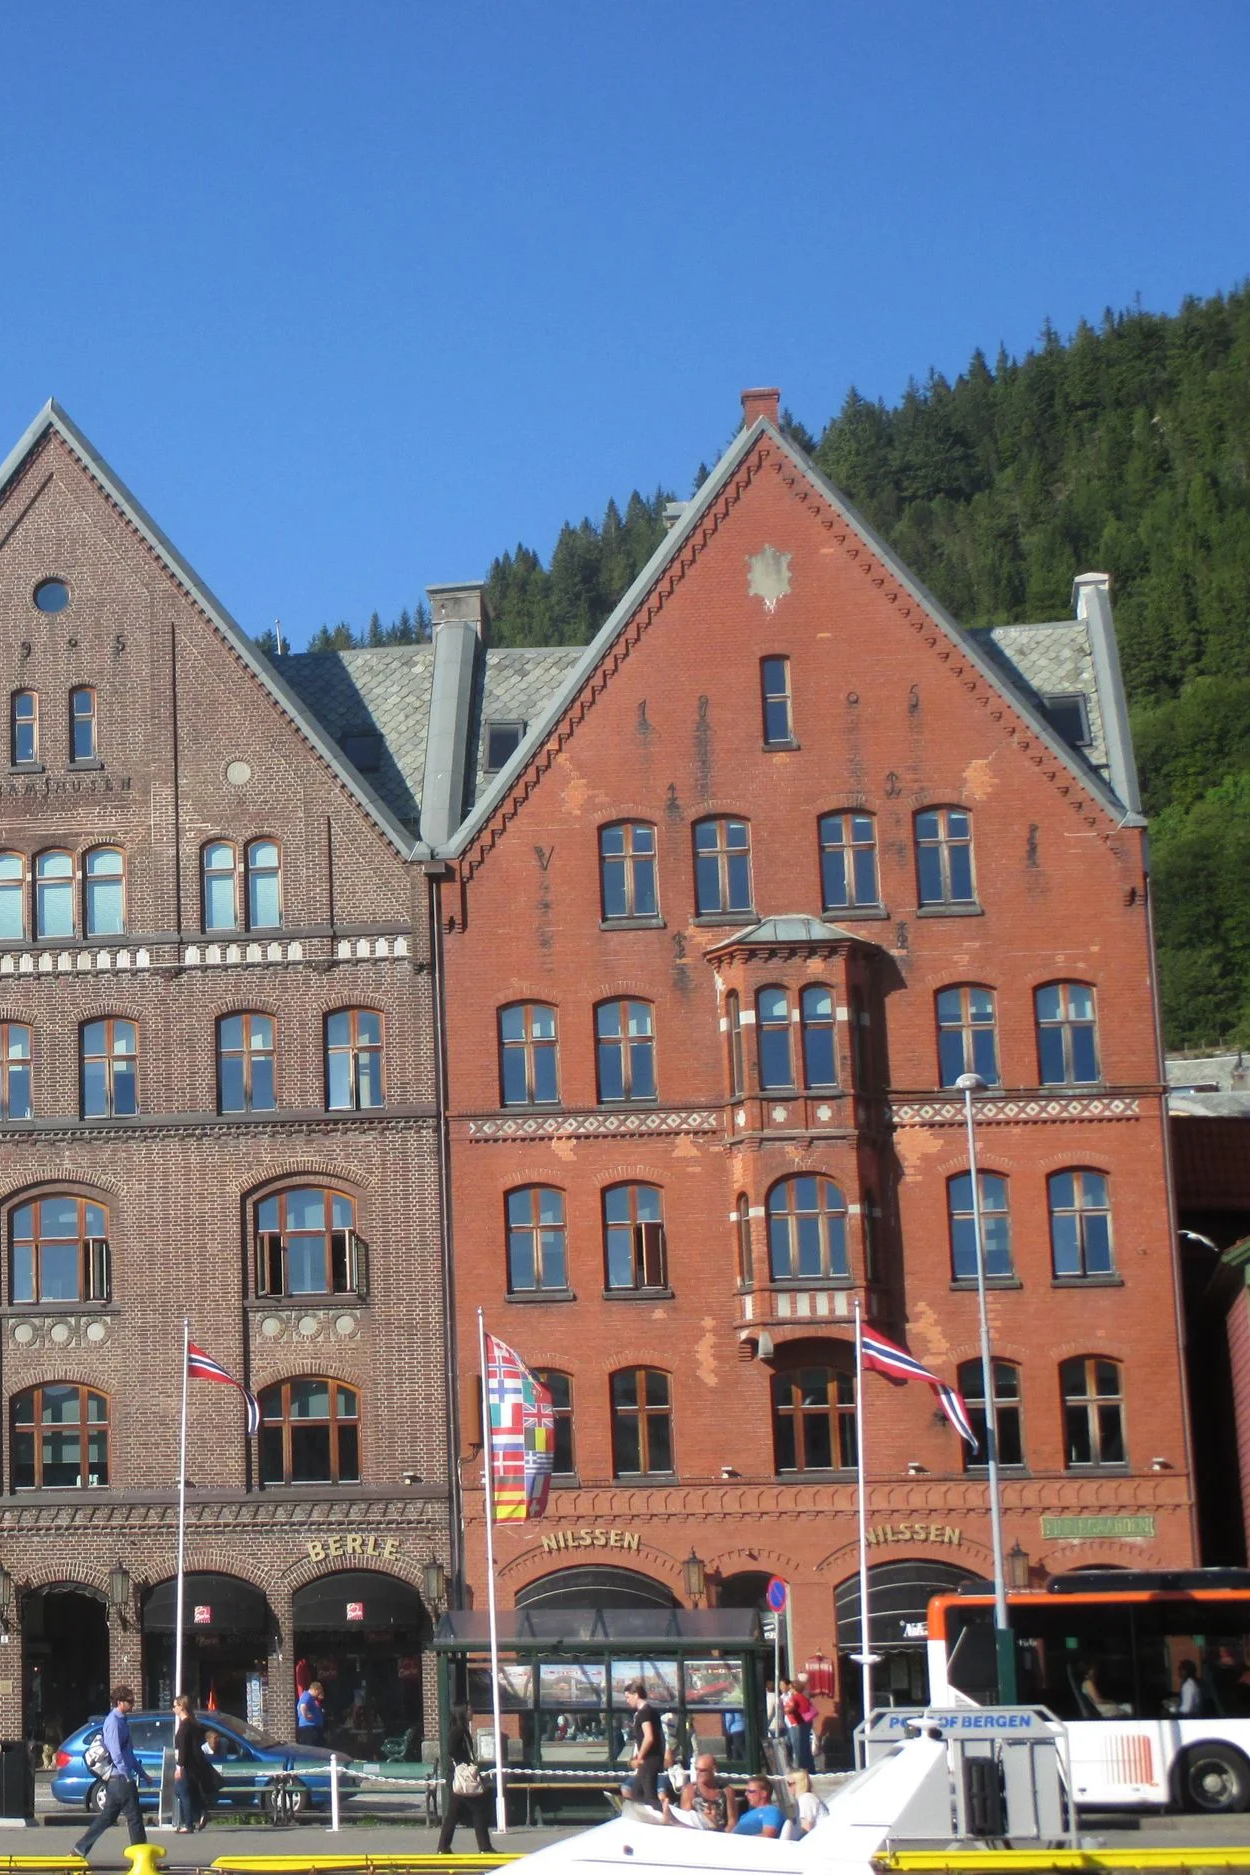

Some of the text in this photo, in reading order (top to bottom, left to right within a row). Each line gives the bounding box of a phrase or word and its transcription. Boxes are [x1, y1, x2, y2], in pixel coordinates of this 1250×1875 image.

[541, 1529, 640, 1551] NILSSEN
[865, 1523, 960, 1545] NILSSEN
[307, 1534, 400, 1562] BERLE
[961, 1714, 1031, 1729] BERGEN
